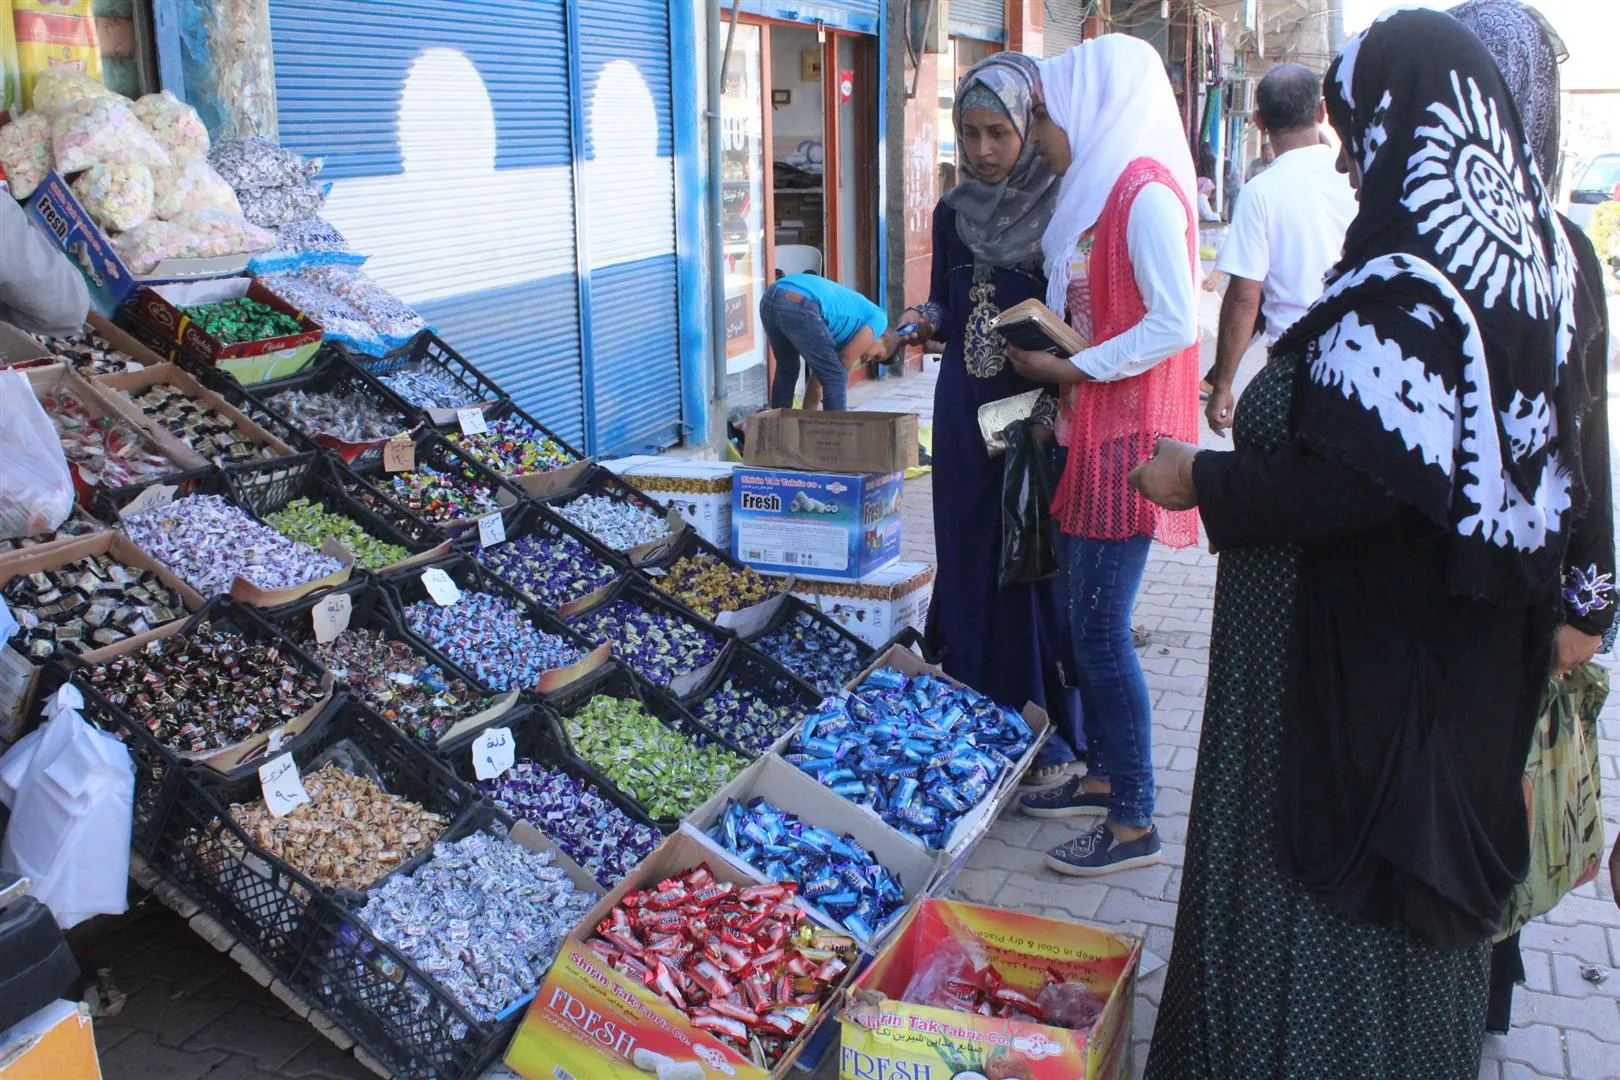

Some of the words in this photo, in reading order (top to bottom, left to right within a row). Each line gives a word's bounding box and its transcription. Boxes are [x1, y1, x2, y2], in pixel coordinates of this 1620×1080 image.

[37, 195, 68, 239] Fresh
[743, 493, 780, 511] Fresh
[1009, 935, 1024, 945] dry
[1027, 940, 1035, 948] &
[1037, 943, 1060, 954] Cool
[1076, 951, 1102, 962] Keep
[569, 951, 609, 986] Shirin
[612, 981, 638, 1007] Tak
[638, 1002, 671, 1032] Tabriz
[547, 984, 638, 1059] FRESH
[909, 1015, 938, 1033] Tak
[941, 1023, 983, 1041] Tabriz
